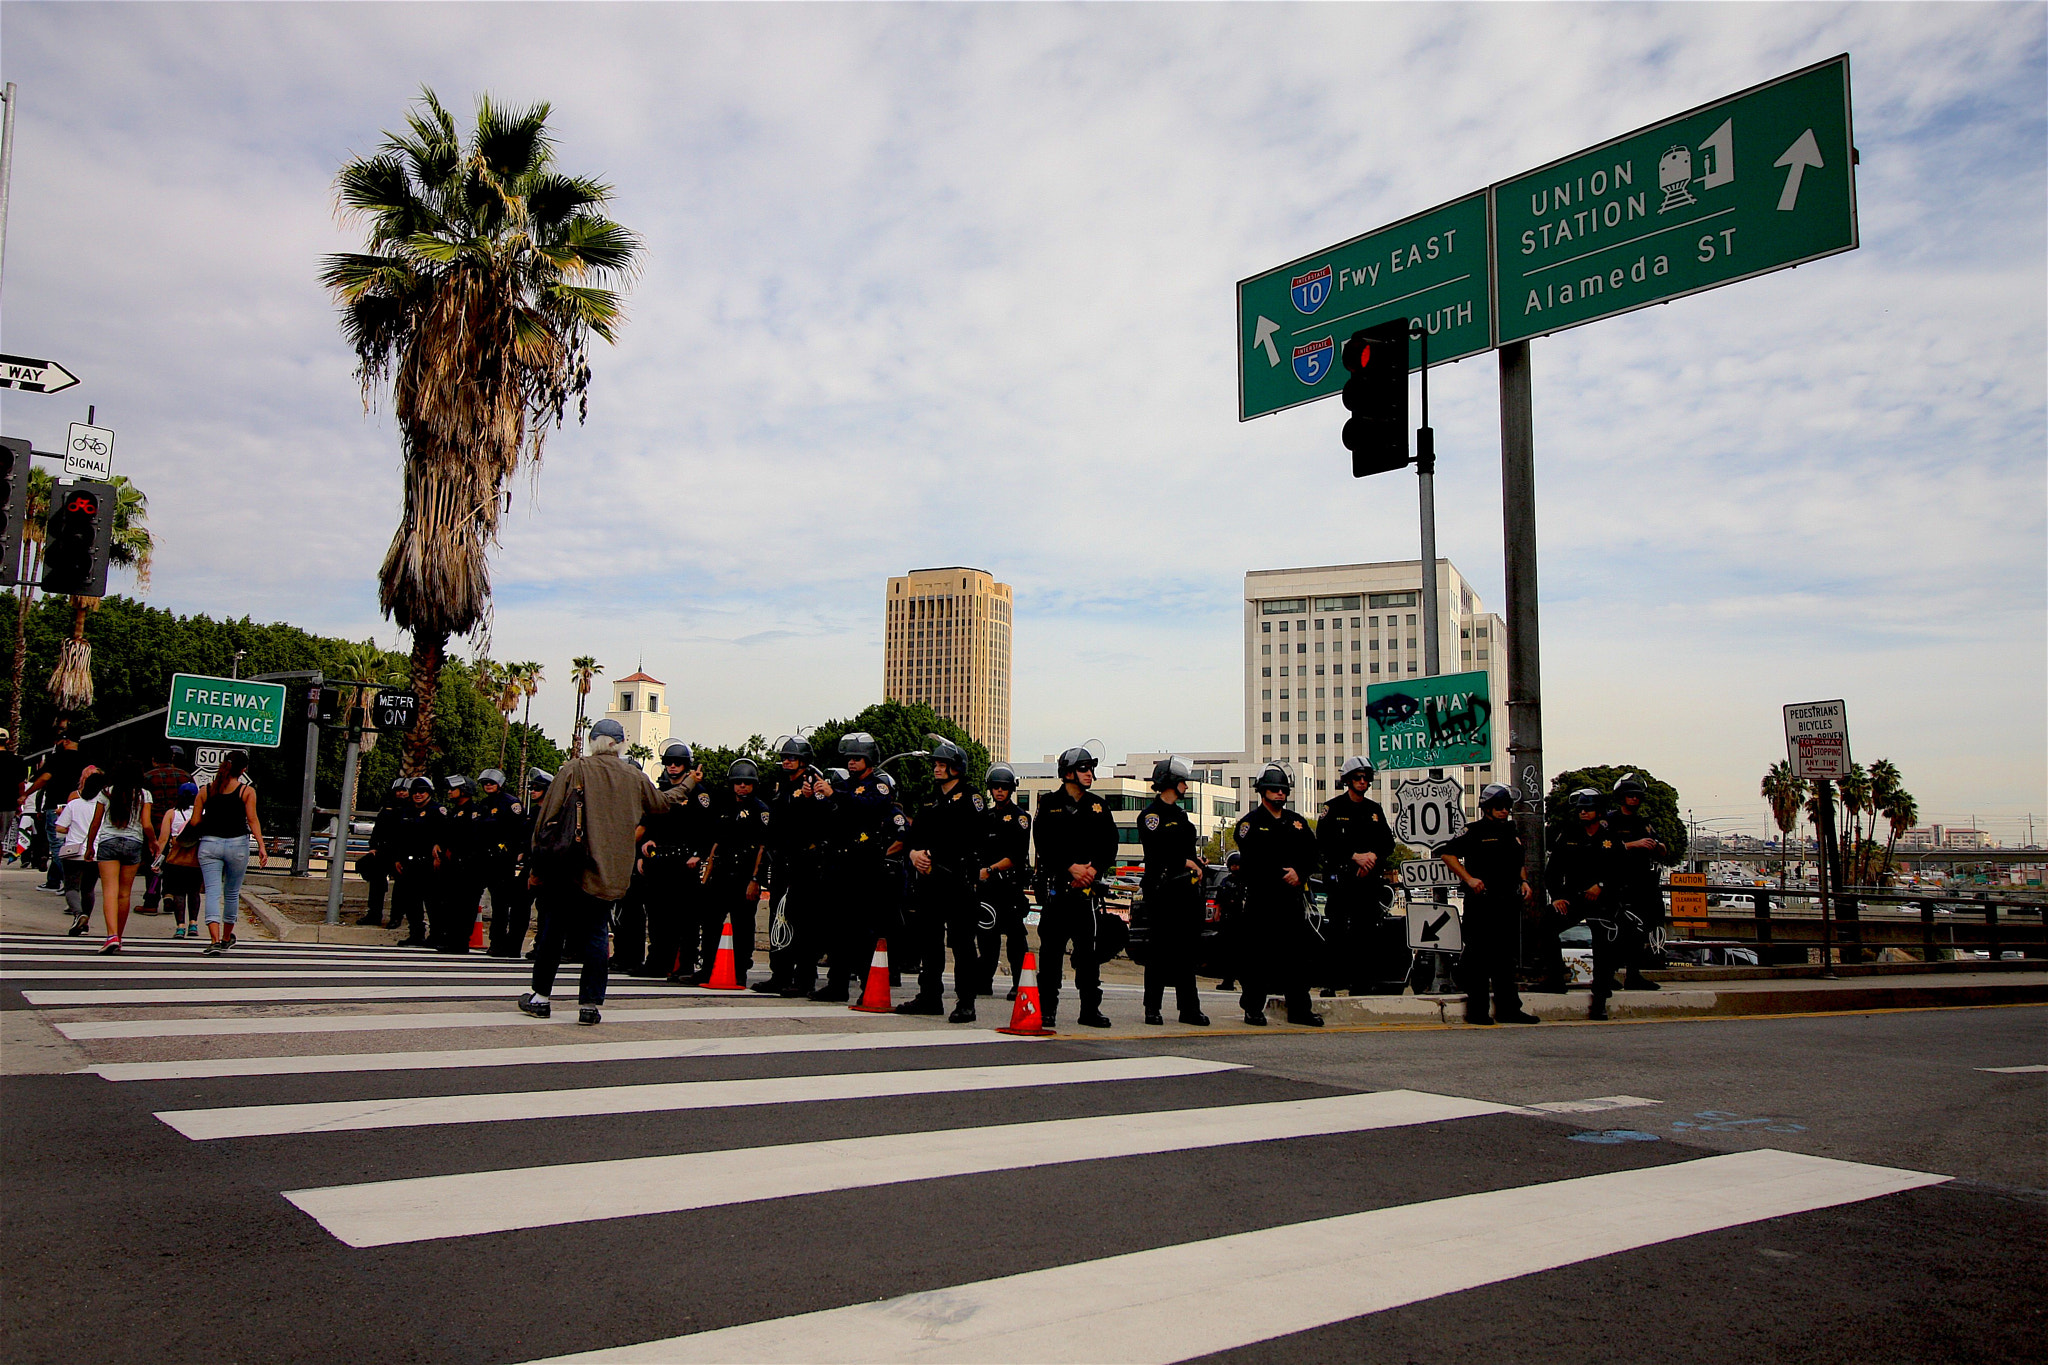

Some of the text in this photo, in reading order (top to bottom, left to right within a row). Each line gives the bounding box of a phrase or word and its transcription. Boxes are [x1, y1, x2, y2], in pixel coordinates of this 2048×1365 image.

[1532, 160, 1632, 216] UNION
[1521, 192, 1646, 254] STATION
[1339, 229, 1456, 291] Fwy EAST
[1296, 269, 1326, 285] INTERSTATE
[1524, 228, 1736, 315] Alameda ST
[1302, 282, 1322, 307] 10
[1408, 300, 1472, 340] OUTH
[1297, 341, 1328, 355] INTERSTATE
[9, 366, 44, 381] WAY
[1308, 354, 1320, 377] 5
[68, 456, 106, 473] SIGNAL
[185, 688, 271, 710] FREEWAY
[379, 695, 414, 708] METER
[384, 709, 406, 725] ON
[1790, 706, 1838, 719] PEDESTRIANS
[175, 711, 274, 733] ENTRANCE
[1798, 719, 1833, 732] BICYCLES
[199, 750, 227, 764] SOU
[1800, 746, 1842, 757] NO STOPPING
[1822, 759, 1839, 767] TIME
[1407, 801, 1454, 836] 101
[1673, 876, 1703, 884] CAUTION
